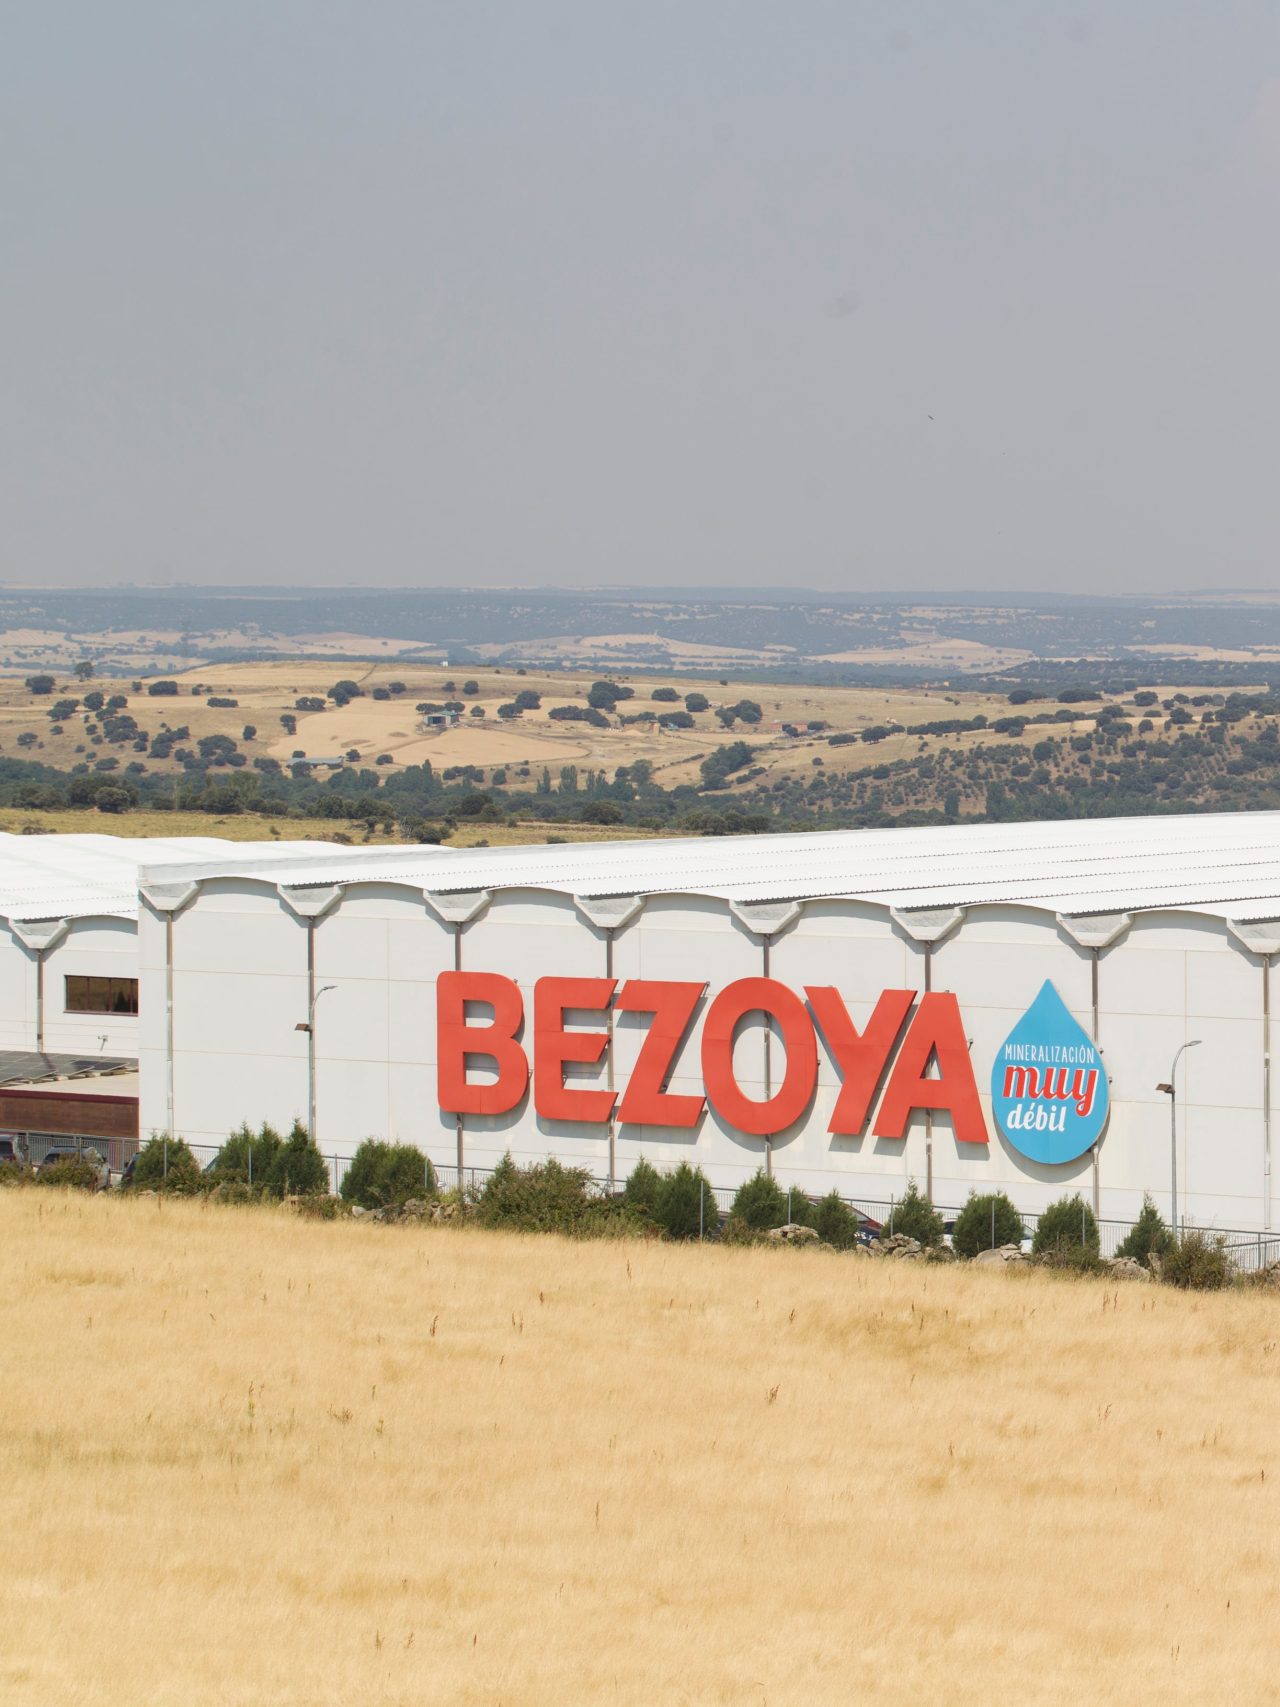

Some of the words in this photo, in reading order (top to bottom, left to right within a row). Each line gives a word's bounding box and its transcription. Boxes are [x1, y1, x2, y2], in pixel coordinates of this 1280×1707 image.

[437, 970, 989, 1143] BEZOYA
[1004, 1043, 1095, 1064] MINERALIZACIÓN
[1002, 1065, 1099, 1117] muy
[1006, 1102, 1067, 1132] débil
